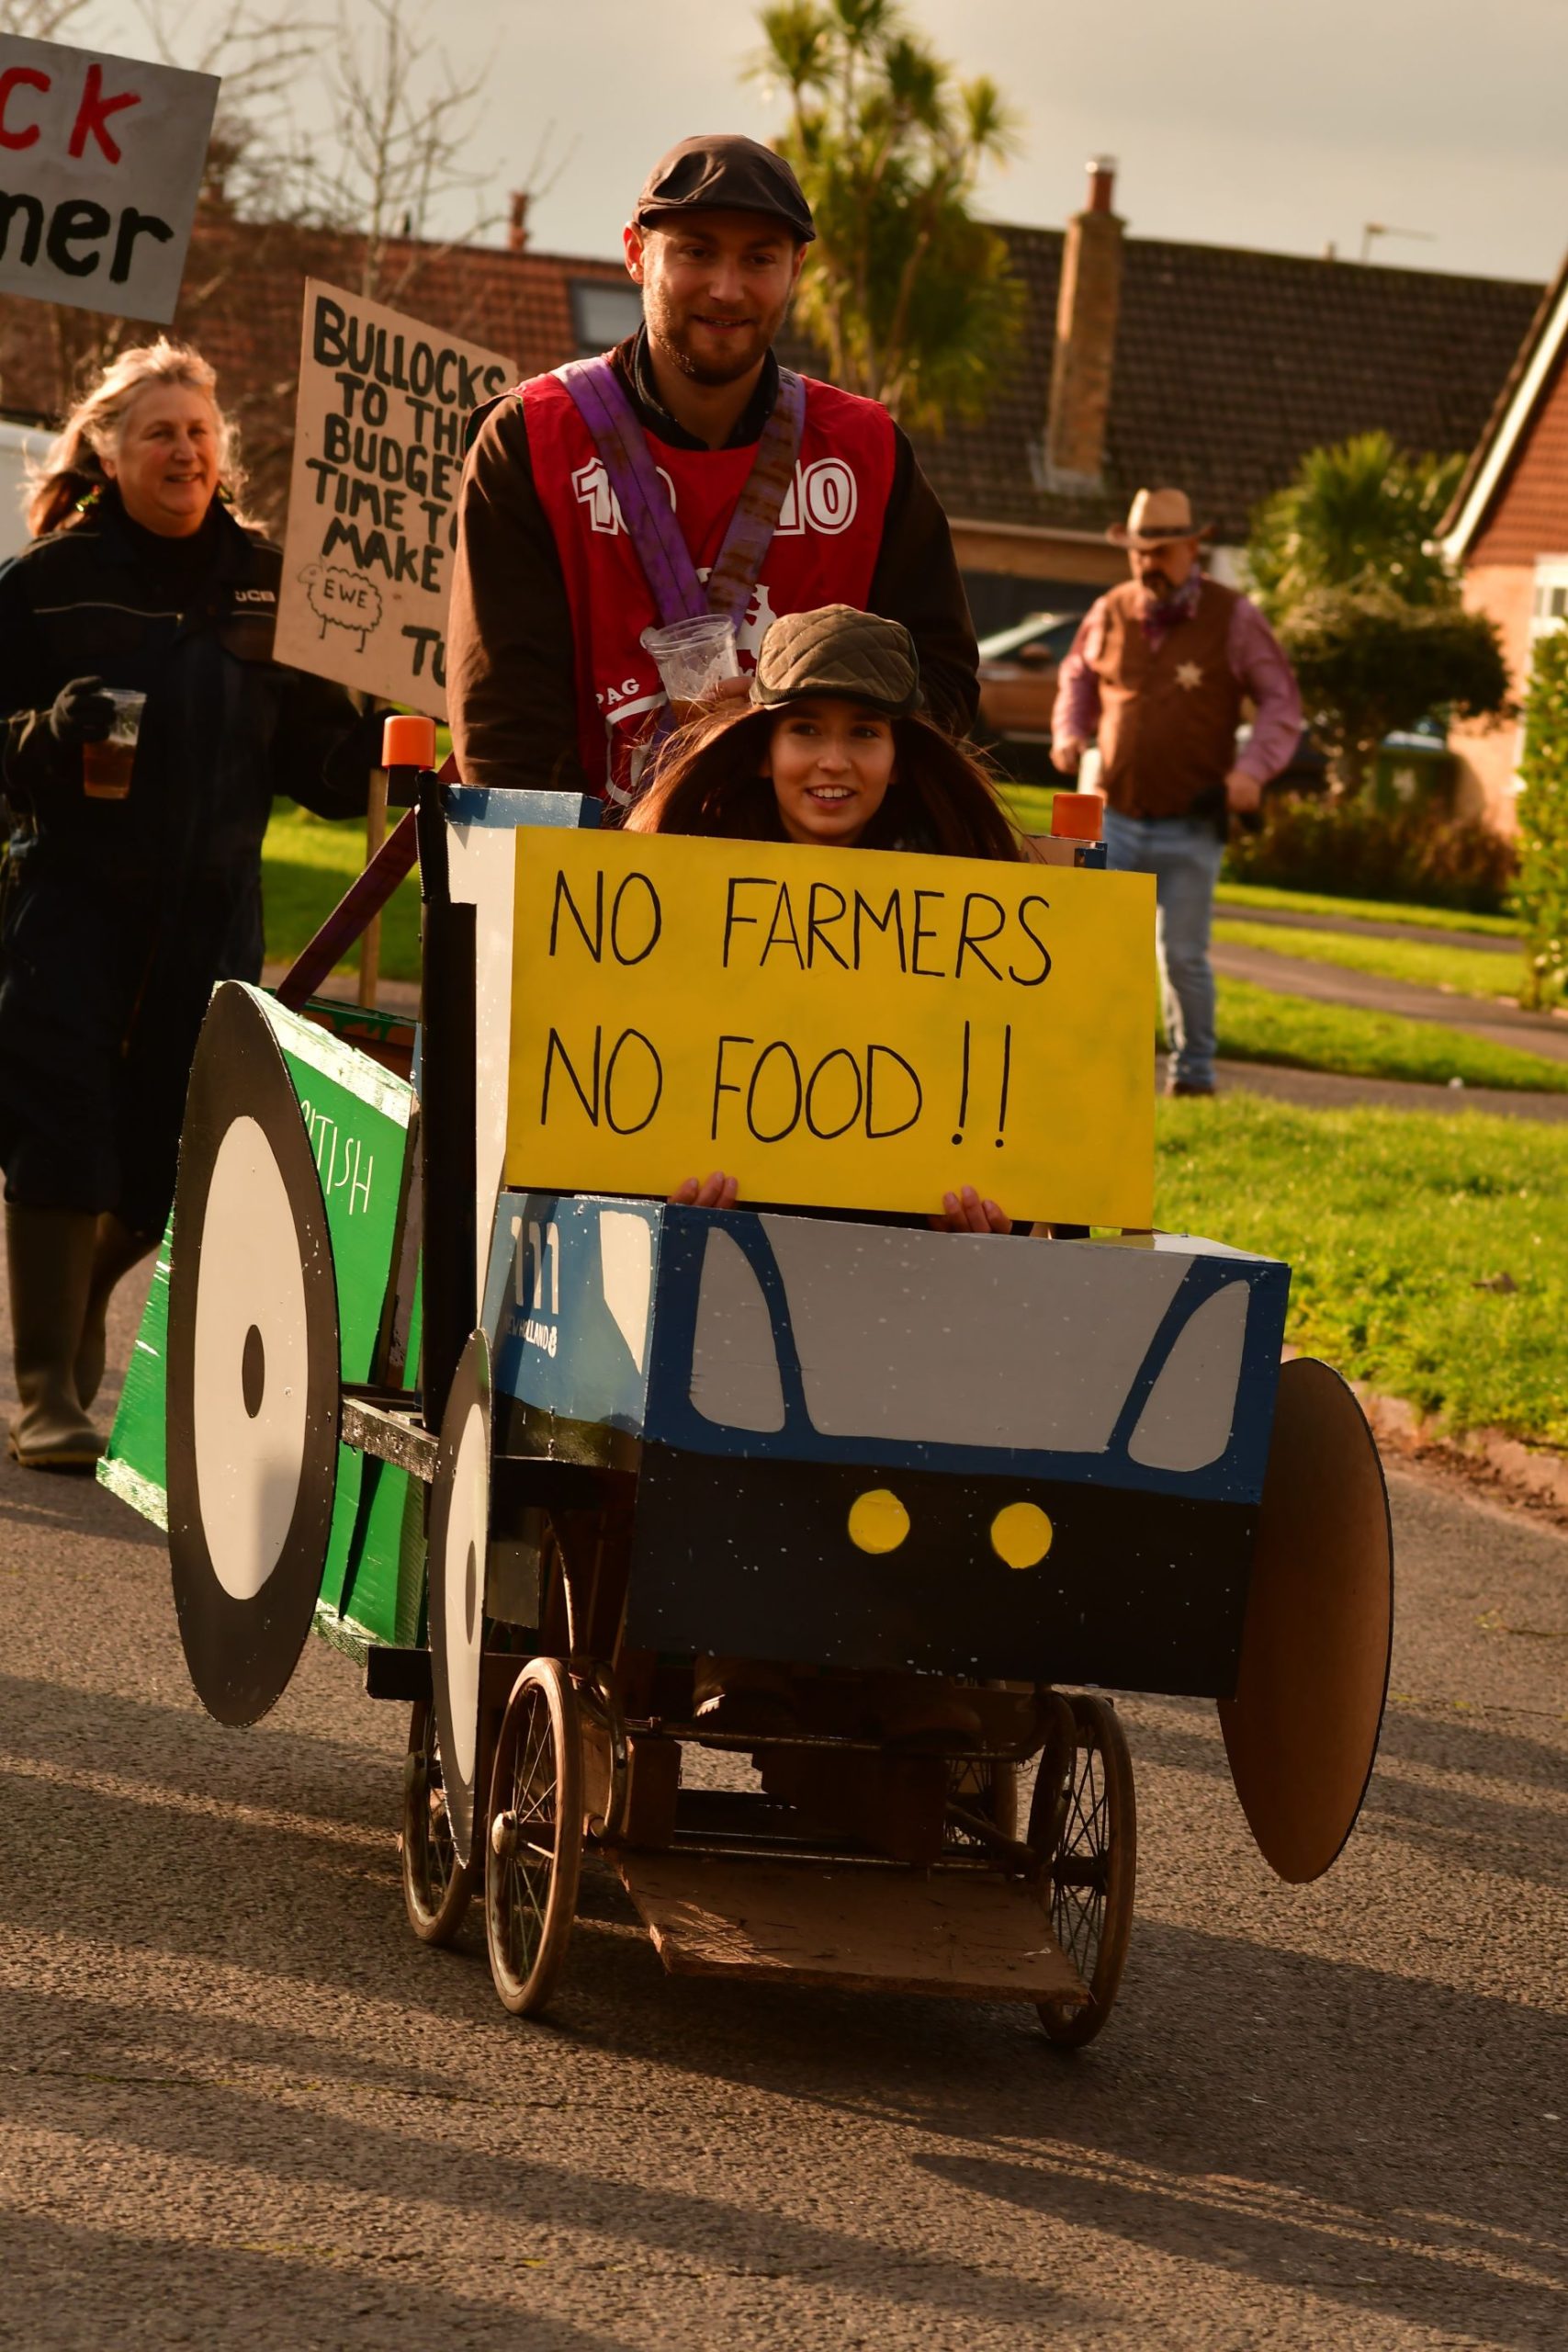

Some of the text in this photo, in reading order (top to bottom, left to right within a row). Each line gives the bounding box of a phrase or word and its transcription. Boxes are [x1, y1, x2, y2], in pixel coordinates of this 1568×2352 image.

[313, 295, 506, 410] BULLOCKS
[335, 372, 388, 426] TO
[306, 458, 407, 531] TIME
[324, 413, 463, 502] BUDGE
[321, 516, 444, 594] MAKE
[323, 579, 367, 608] EWE
[548, 870, 1051, 986] NO FARMERS
[541, 1025, 662, 1134] NO
